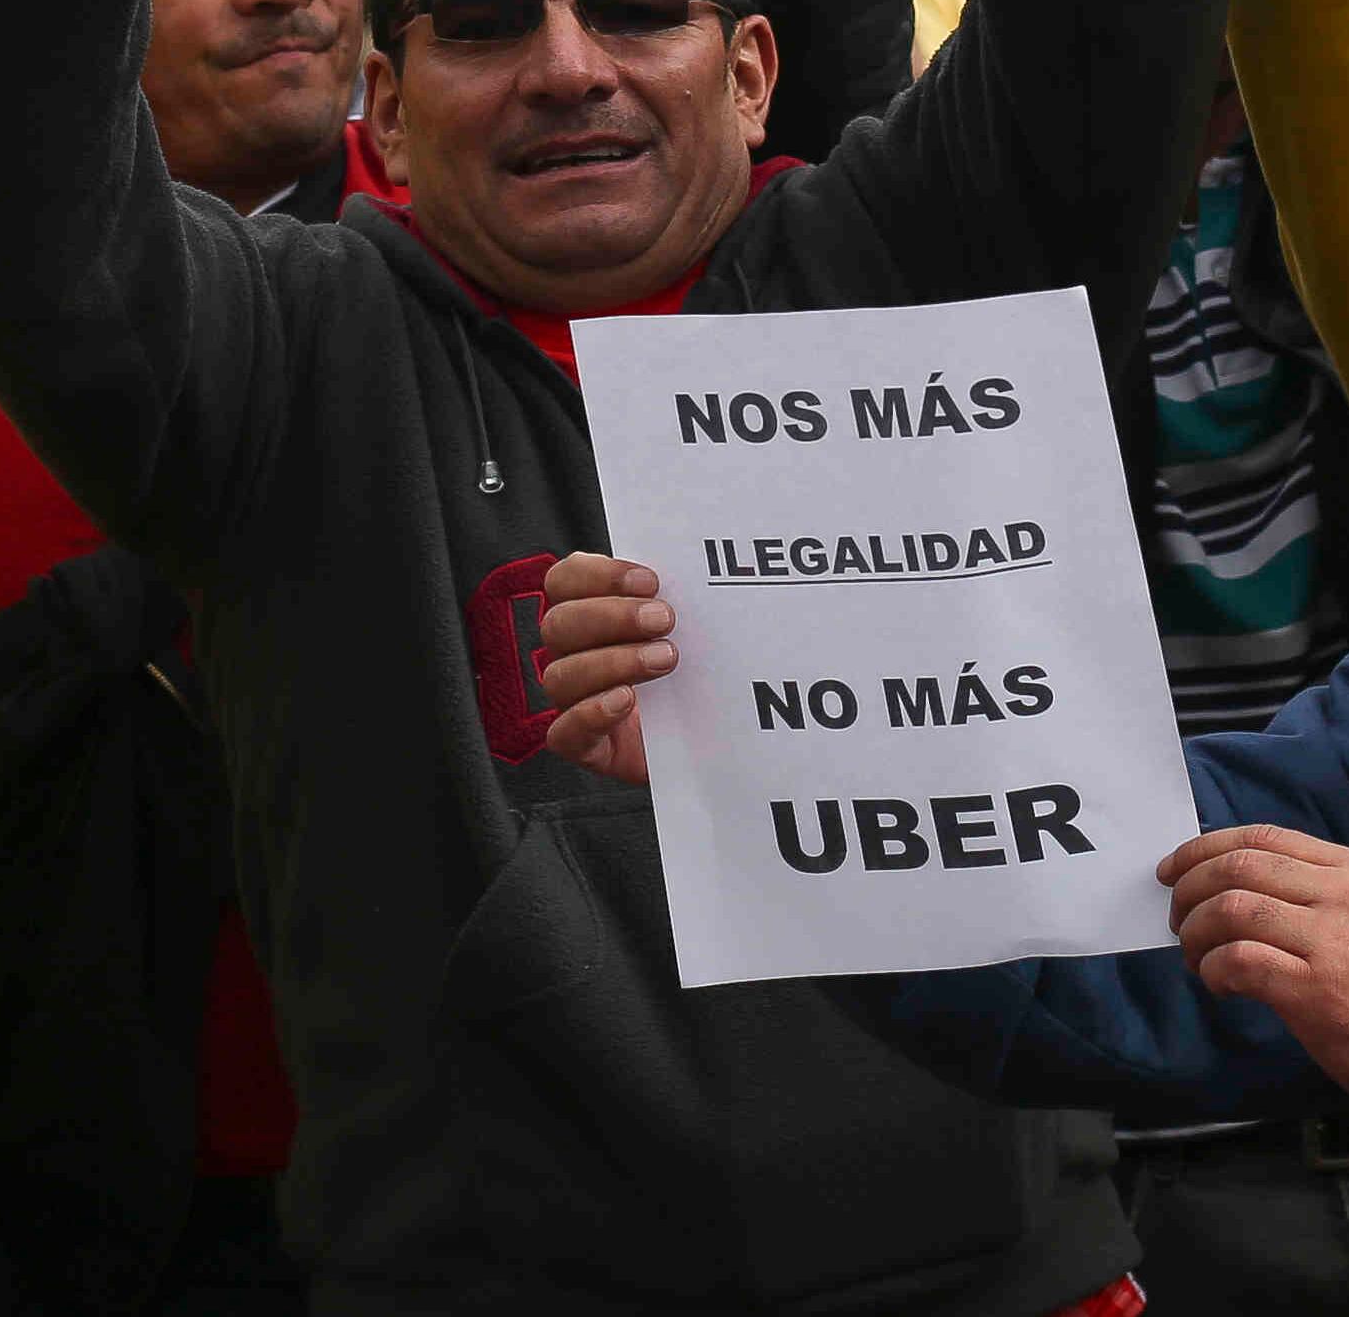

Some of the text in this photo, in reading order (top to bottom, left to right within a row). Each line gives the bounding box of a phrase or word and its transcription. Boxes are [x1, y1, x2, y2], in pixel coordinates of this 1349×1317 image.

[674, 371, 1021, 444] NOS MÁS
[703, 521, 1046, 577] ILEGALIDAD
[751, 661, 1054, 731] NO MÁS
[769, 784, 1097, 874] UBER
